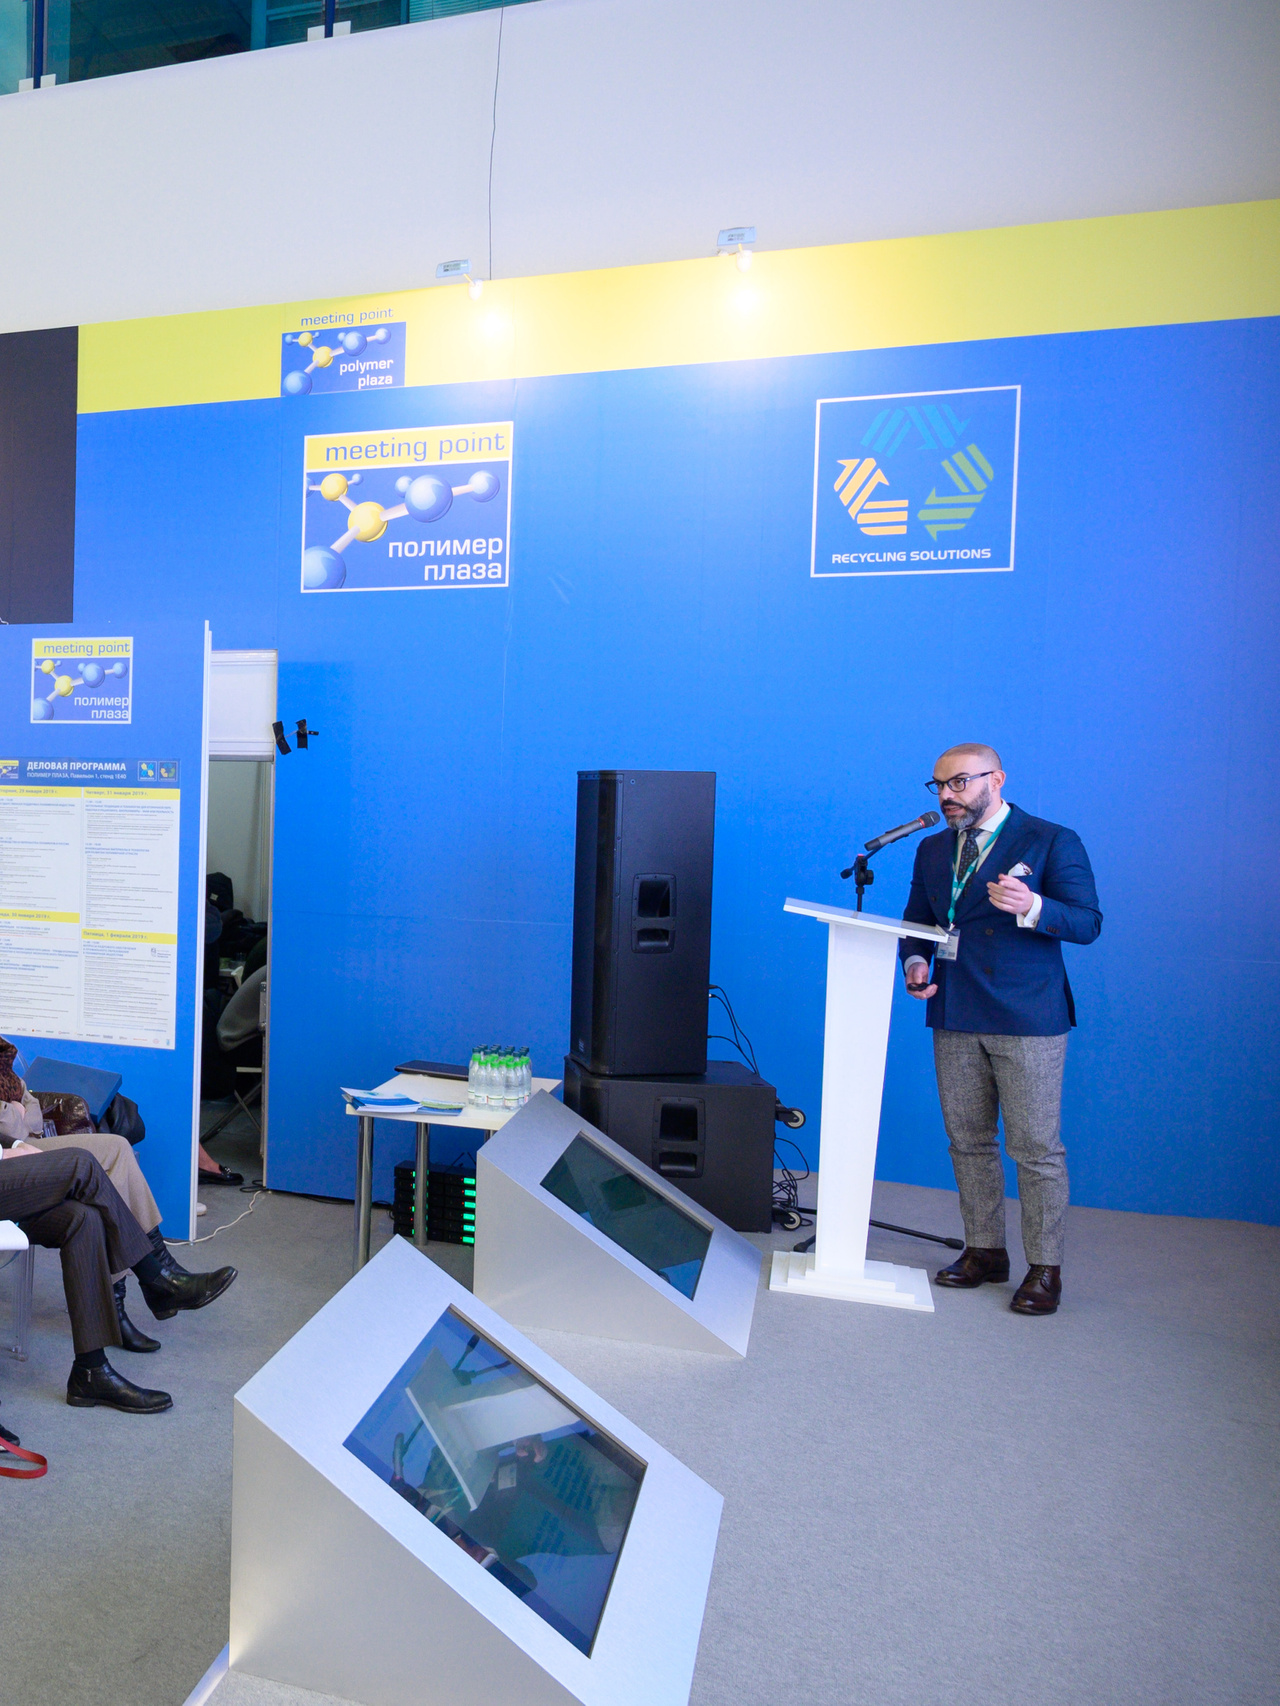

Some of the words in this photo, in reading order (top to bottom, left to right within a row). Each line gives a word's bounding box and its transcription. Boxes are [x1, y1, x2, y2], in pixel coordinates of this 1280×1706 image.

[301, 312, 354, 326] meeting
[360, 308, 394, 323] point
[340, 359, 394, 376] polymer
[358, 374, 393, 390] plaza
[326, 437, 427, 462] meeting
[439, 432, 505, 460] point
[388, 537, 504, 560] полимер
[832, 551, 906, 564] RECYCLING
[910, 548, 992, 562] SOLUTIONS
[424, 562, 502, 581] плаза
[44, 642, 94, 656] meeting
[98, 641, 130, 655] point
[74, 697, 129, 709] полимер
[91, 710, 129, 719] плаза
[26, 762, 68, 771] ДЕЛОВАЯ
[70, 762, 126, 771] ПРОГРАММА
